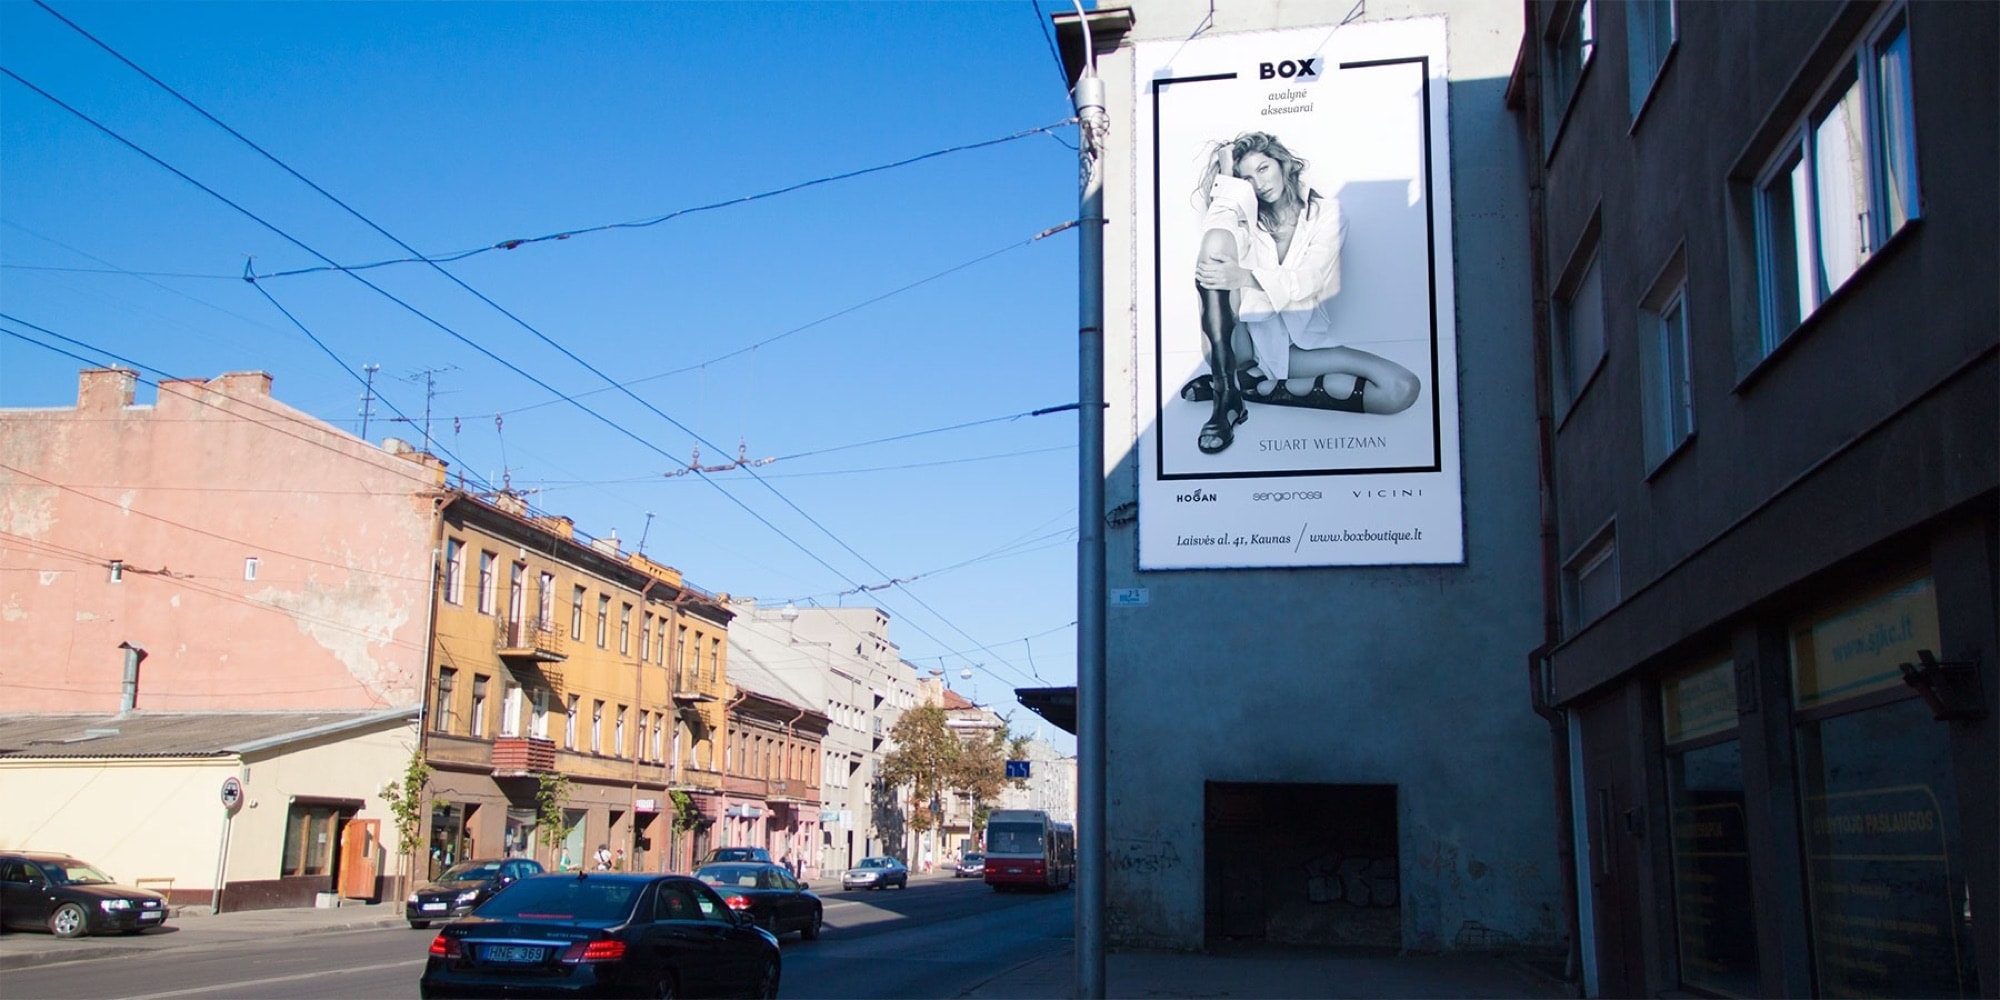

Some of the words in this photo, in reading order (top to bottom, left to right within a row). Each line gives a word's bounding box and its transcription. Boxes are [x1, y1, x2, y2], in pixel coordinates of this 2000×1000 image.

[1259, 58, 1316, 80] BOX
[1268, 88, 1308, 103] avalynė
[1260, 102, 1314, 116] aksesuarai
[1259, 438, 1308, 452] STUART
[1313, 436, 1387, 450] WEITZMAN
[1176, 493, 1218, 503] HOGAN
[1352, 488, 1422, 499] VICINI
[1176, 534, 1216, 547] Laisvės
[1217, 532, 1231, 546] al.
[1250, 533, 1292, 545] Kaunas
[1309, 527, 1423, 545] www.boxboutique.lt
[1865, 808, 1934, 833] PASLAUGOS
[489, 946, 513, 960] HNE
[521, 947, 542, 960] 369
